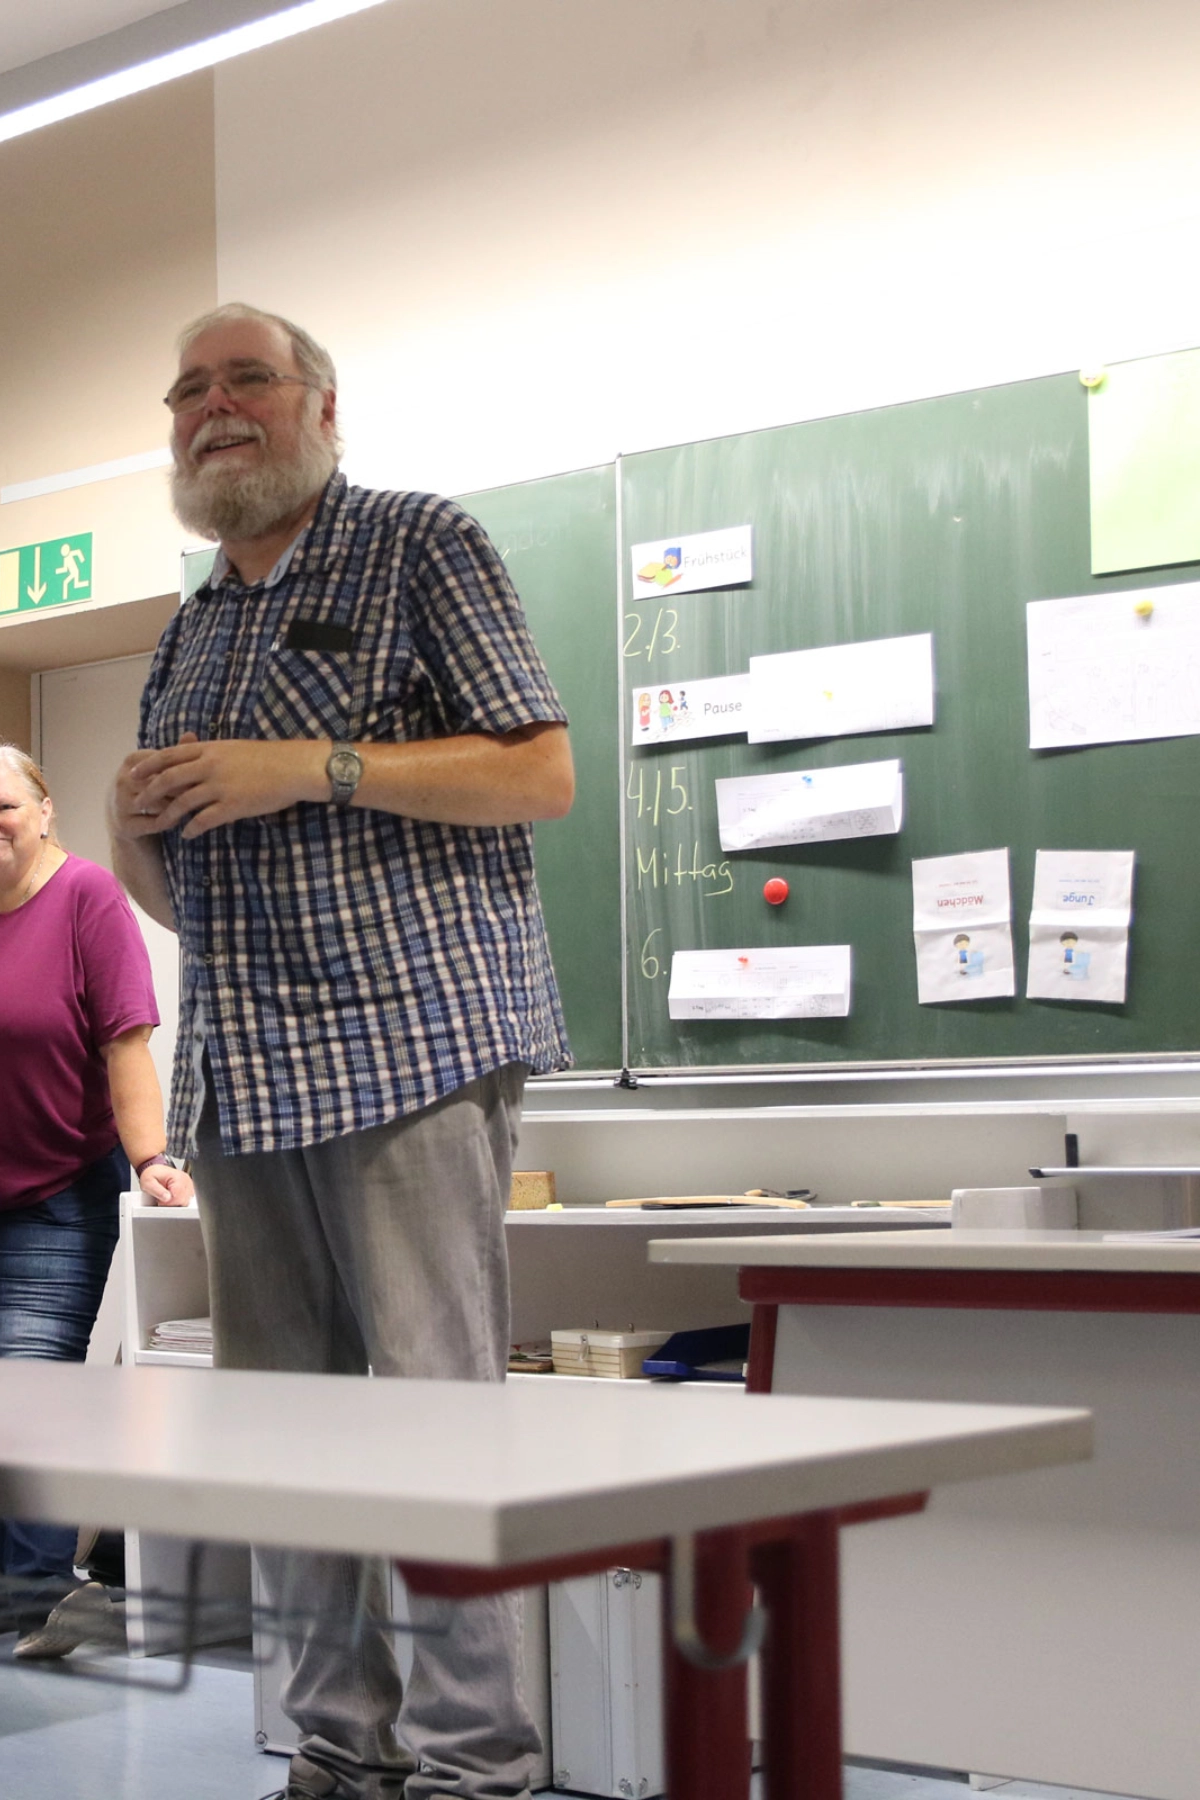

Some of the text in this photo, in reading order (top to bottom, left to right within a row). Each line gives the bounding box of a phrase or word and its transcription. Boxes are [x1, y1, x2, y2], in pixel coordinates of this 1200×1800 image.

[683, 546, 748, 568] Frühstück
[703, 700, 743, 717] Pause
[637, 841, 734, 897] Mittag
[937, 894, 984, 908] Mädchen
[1062, 892, 1095, 906] Junge
